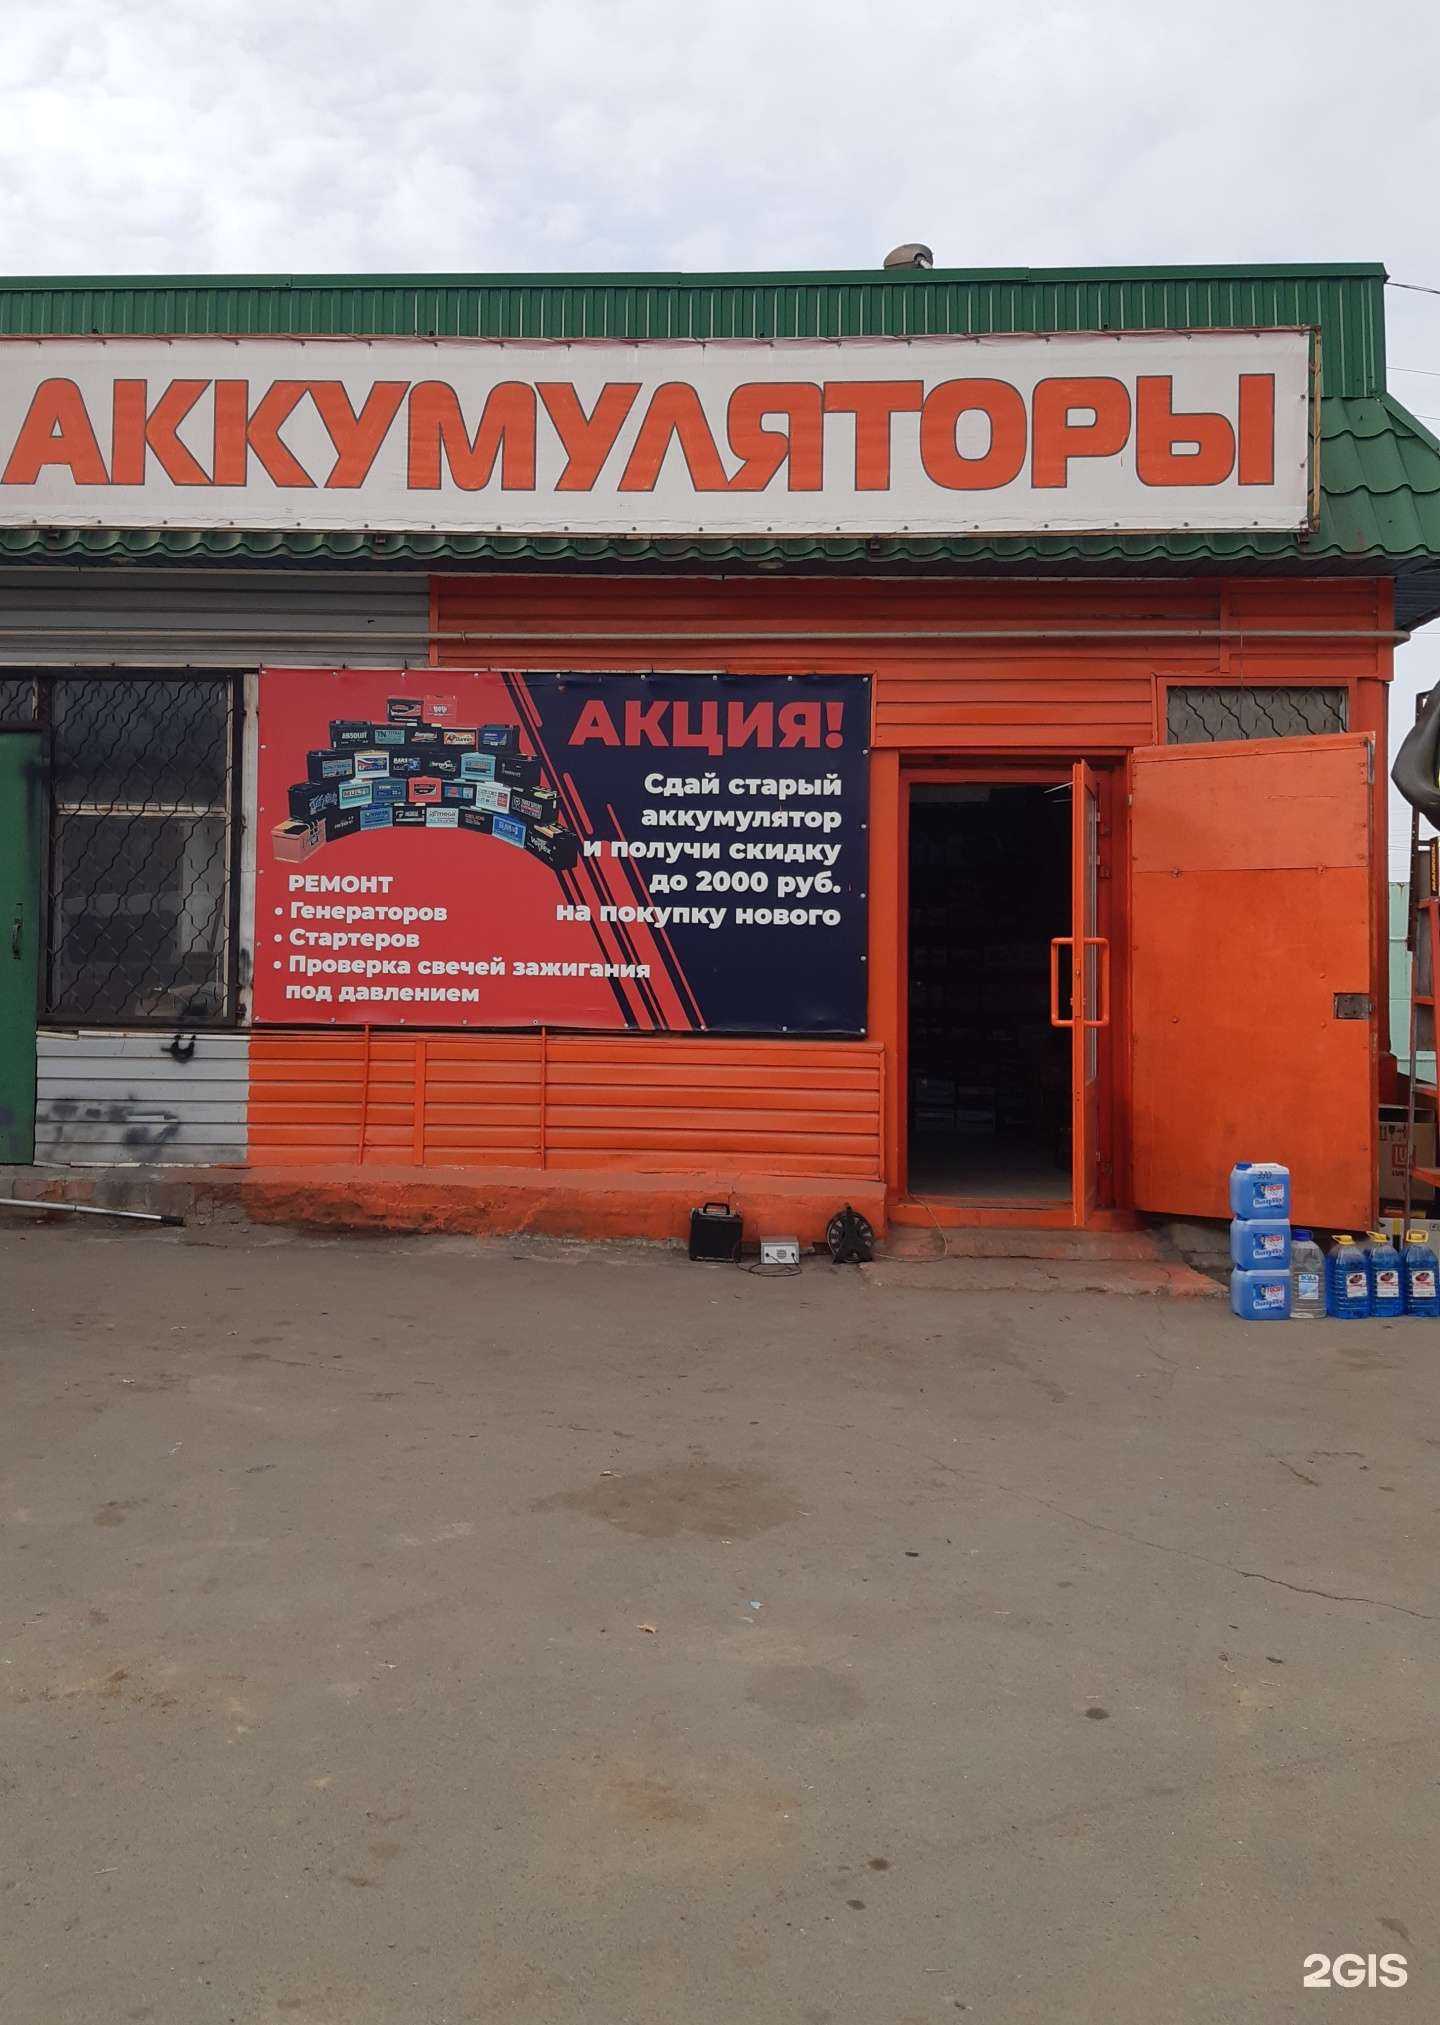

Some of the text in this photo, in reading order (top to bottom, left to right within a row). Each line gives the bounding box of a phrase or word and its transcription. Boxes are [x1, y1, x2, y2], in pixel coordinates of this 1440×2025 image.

[1, 374, 1275, 492] АККУМУЛЯТОРЫ
[567, 699, 844, 756] АКЦИЯ!
[644, 772, 842, 800] Сдай старый
[641, 808, 842, 833] аккумулятор
[583, 840, 841, 865] и получи скидку
[288, 874, 393, 894] РЕМОНТ
[650, 871, 841, 898] до 2000 руб.
[289, 901, 448, 924] Генераторов
[556, 904, 841, 928] на покупку нового
[289, 929, 420, 950] Стартеров
[288, 955, 651, 979] Проверка свечей зажигания
[285, 984, 480, 1003] под давлением
